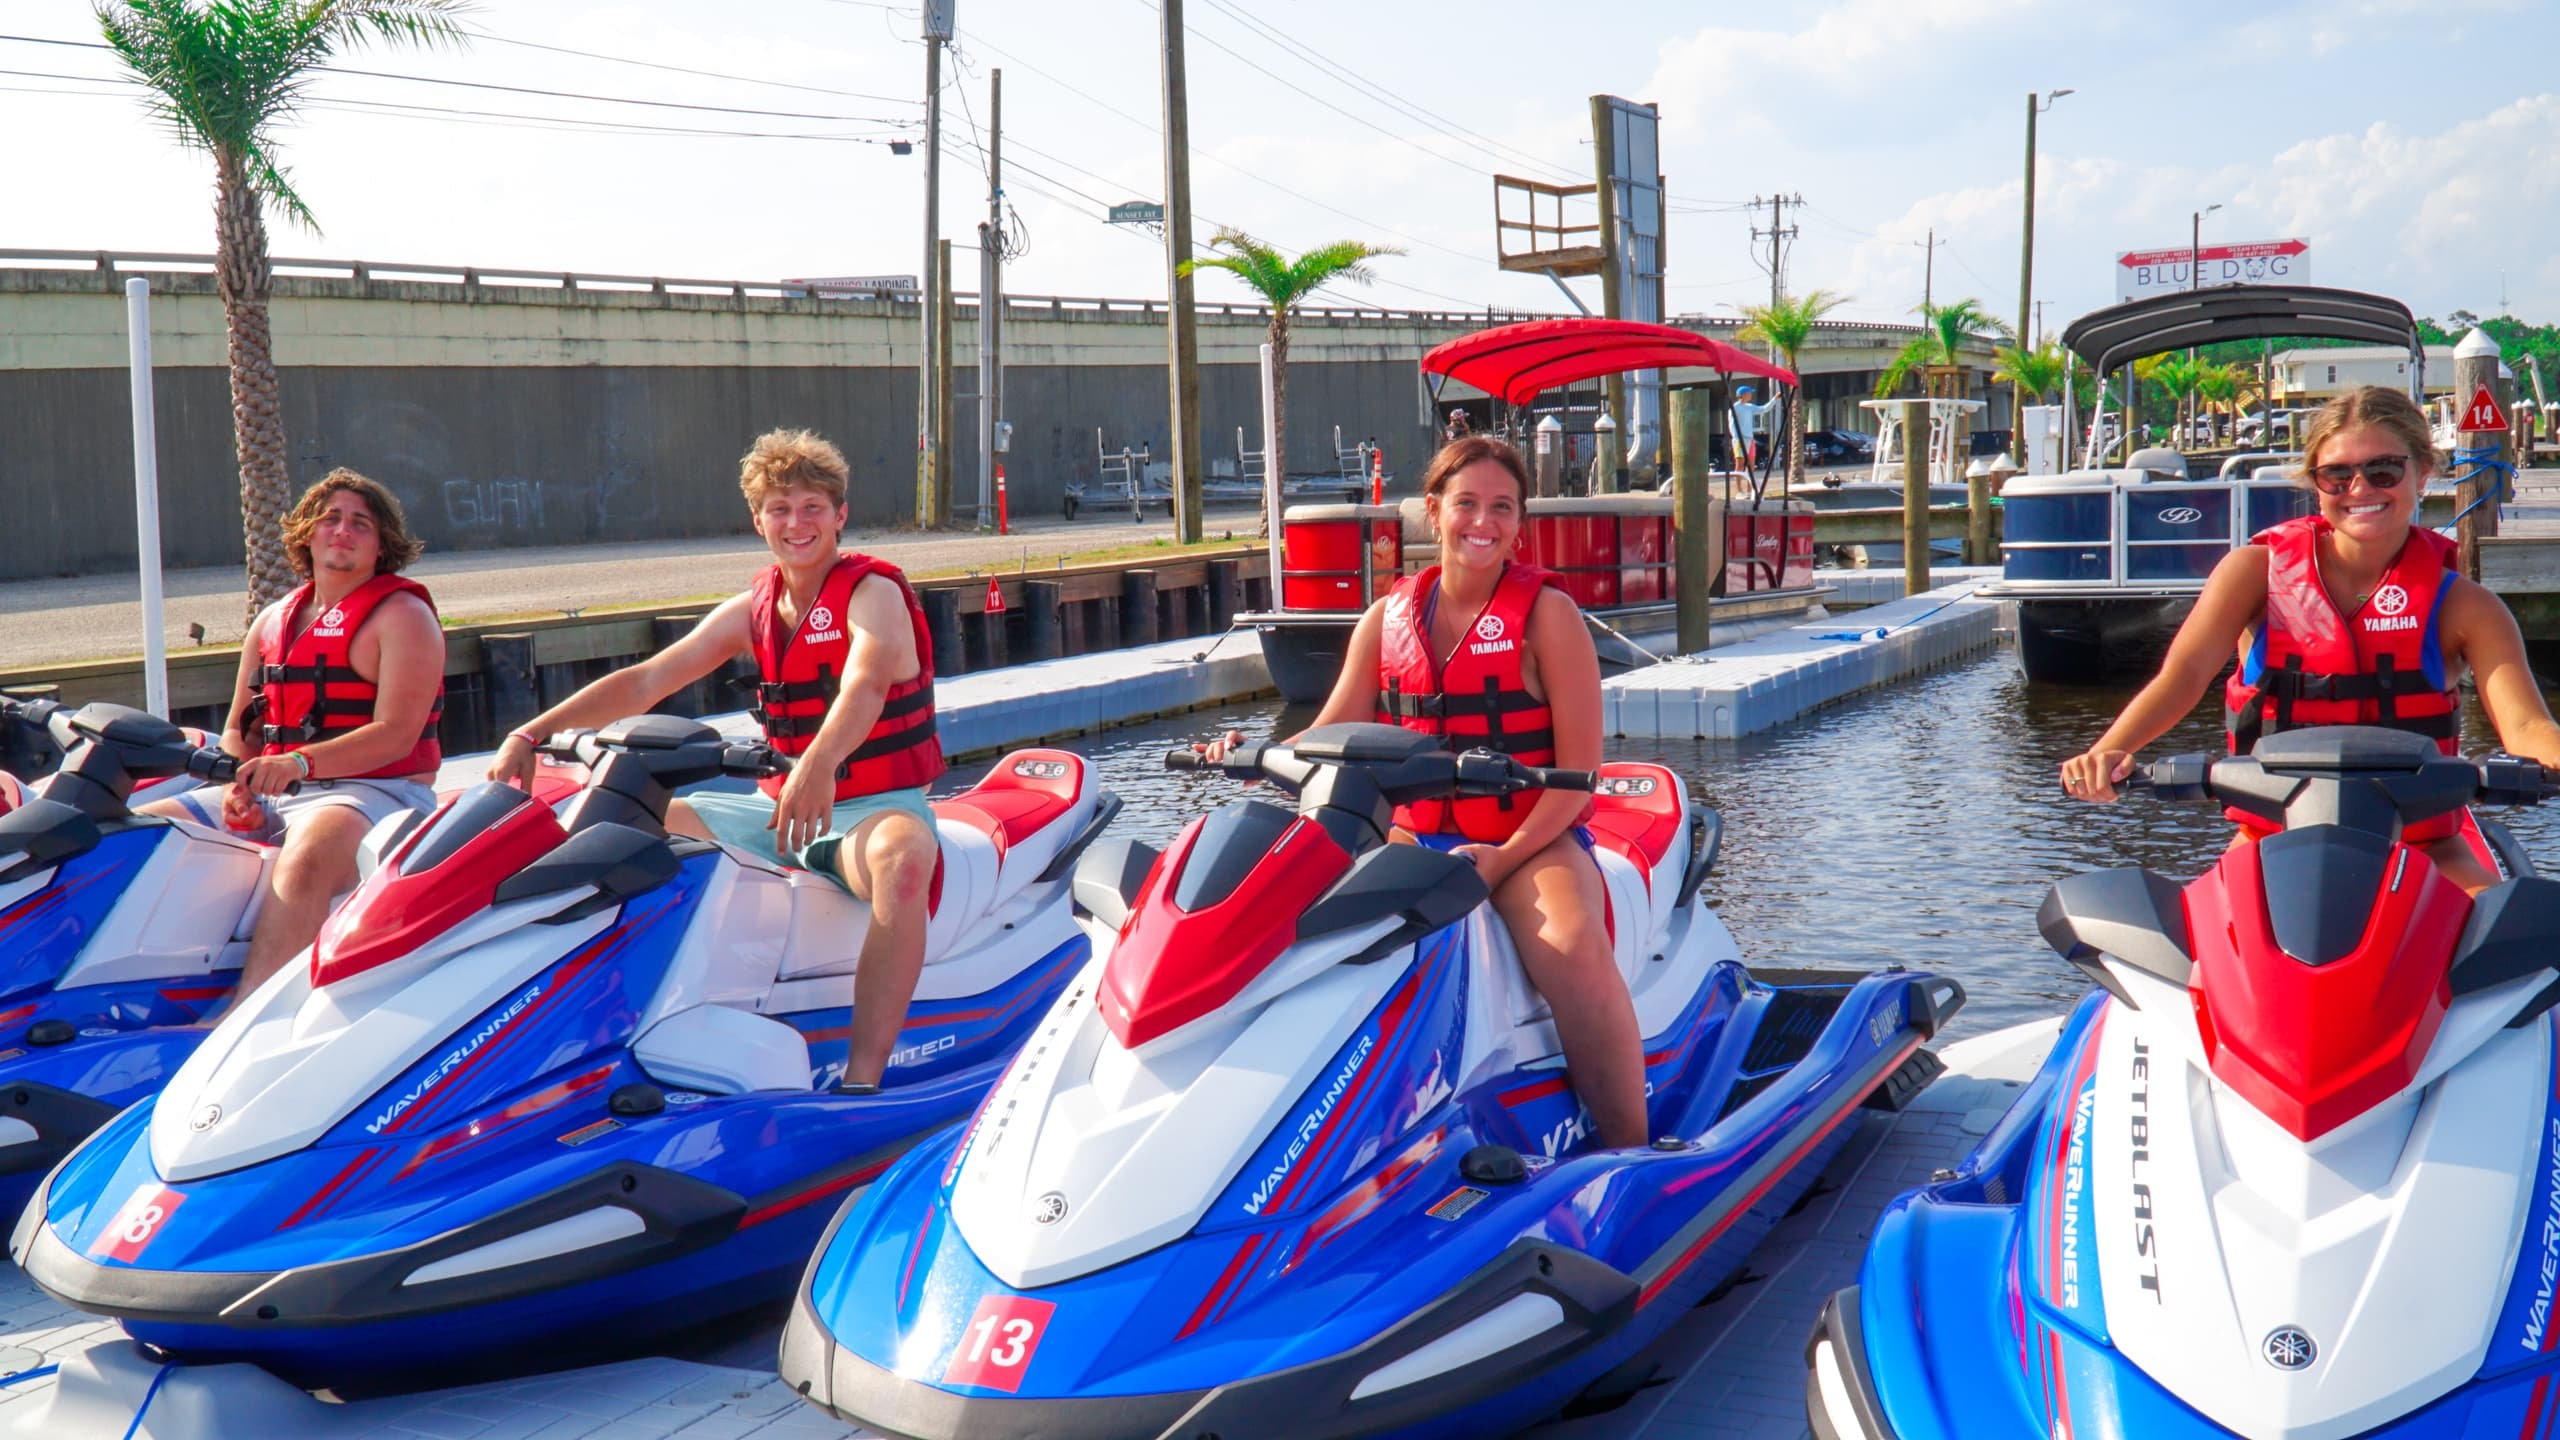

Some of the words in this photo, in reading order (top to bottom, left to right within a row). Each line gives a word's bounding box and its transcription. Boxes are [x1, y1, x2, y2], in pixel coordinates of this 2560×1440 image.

[1115, 211, 1142, 219] SUNSET
[1144, 210, 1158, 218] AVE
[2251, 243, 2281, 251] SPRINGS
[2138, 262, 2208, 286] BLUE
[2473, 405, 2493, 425] 14
[314, 628, 344, 637] YAMAHA
[2363, 615, 2418, 632] YAMAHA
[804, 629, 842, 645] YAMAHA
[1470, 639, 1514, 656] YAMAHA
[365, 985, 541, 1134] WAVERUNNER
[888, 1034, 956, 1068] MITED
[1243, 1035, 1373, 1215] WAVERUNNER
[2131, 1036, 2162, 1305] JETBLAST
[2063, 1089, 2095, 1309] WAVERUNNER
[967, 1314, 1034, 1367] 13
